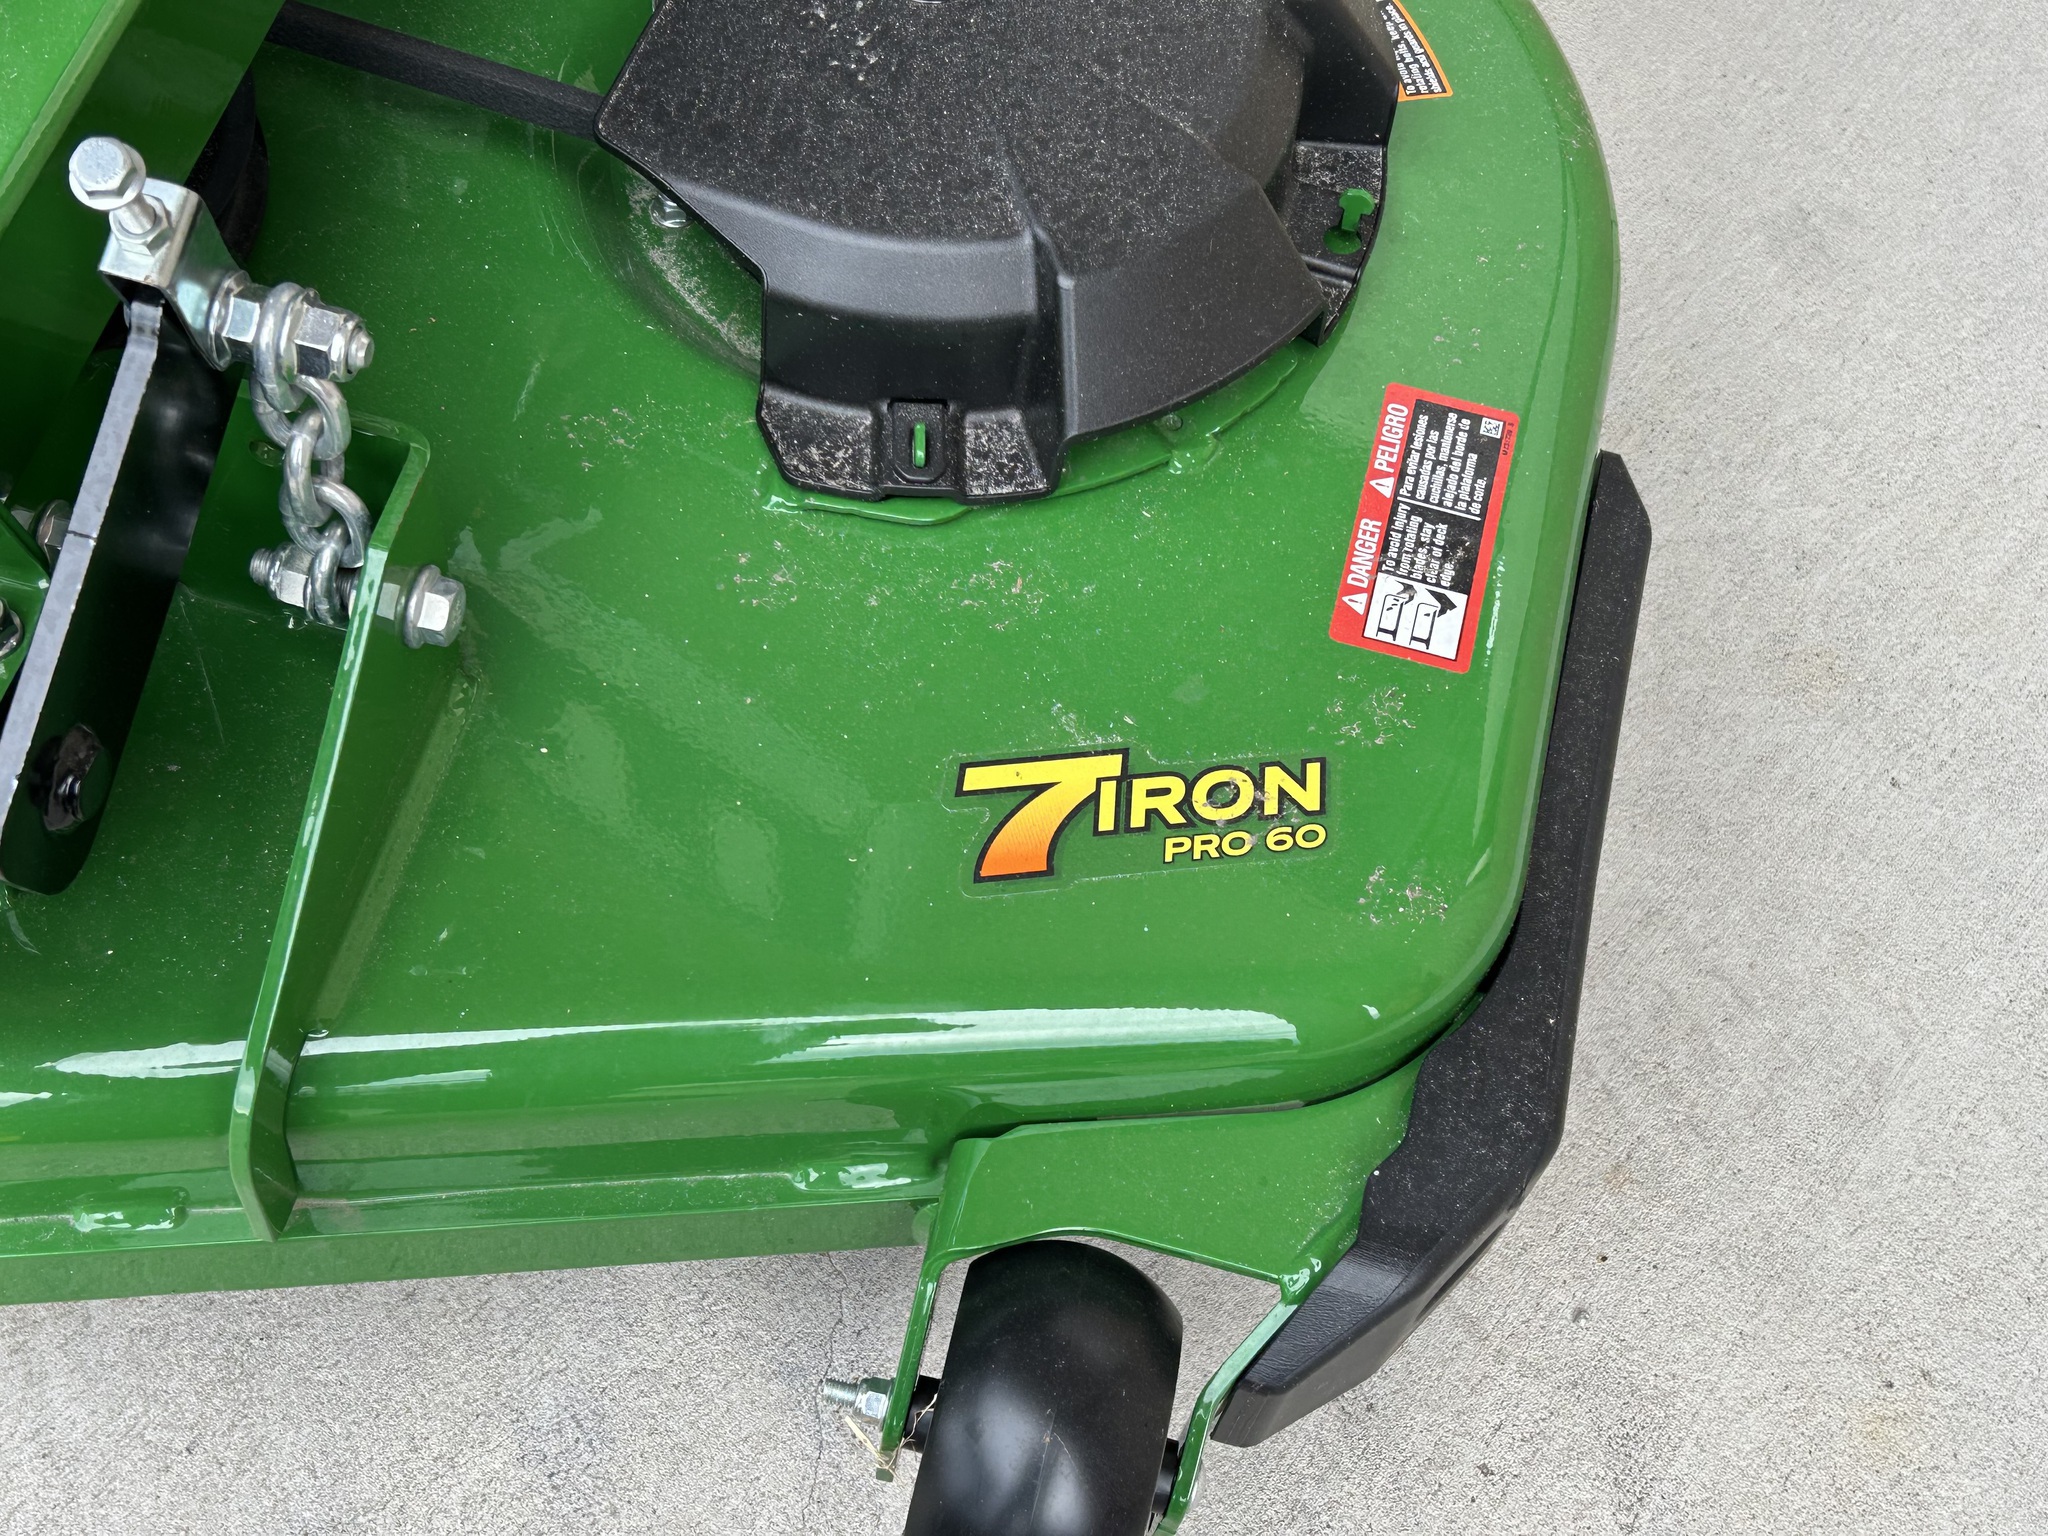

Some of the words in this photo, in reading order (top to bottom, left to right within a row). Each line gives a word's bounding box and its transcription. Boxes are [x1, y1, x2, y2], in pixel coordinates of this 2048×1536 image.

[1398, 23, 1408, 31] in
[1405, 85, 1416, 95] To
[1409, 63, 1429, 93] rotating
[1410, 414, 1428, 449] lesiones
[1426, 430, 1440, 443] las
[1438, 412, 1458, 461] mantenerse
[1458, 419, 1471, 430] de
[1374, 404, 1408, 473] PELIGRO
[1454, 432, 1469, 457] borde
[1406, 450, 1420, 474] evitar
[1424, 444, 1437, 460] por
[1448, 457, 1462, 472] del
[1399, 474, 1414, 496] Para
[1415, 460, 1433, 500] causadas
[1429, 464, 1448, 503] cuchillas,
[1458, 453, 1478, 501] plataforma
[1474, 477, 1487, 501] corte.
[1442, 474, 1458, 507] alejado
[1391, 503, 1411, 530] injury
[1454, 501, 1467, 511] la
[1469, 503, 1482, 514] de
[1402, 516, 1423, 552] rotating
[1420, 522, 1435, 543] stay
[1433, 523, 1448, 546] deck
[1347, 518, 1382, 588] DANGER
[1389, 532, 1401, 558] avoid
[1431, 546, 1442, 557] of
[1381, 560, 1395, 571] To
[1396, 554, 1412, 576] from
[1425, 559, 1440, 584] clear
[1163, 829, 1253, 863] PRO
[1265, 823, 1327, 852] 60
